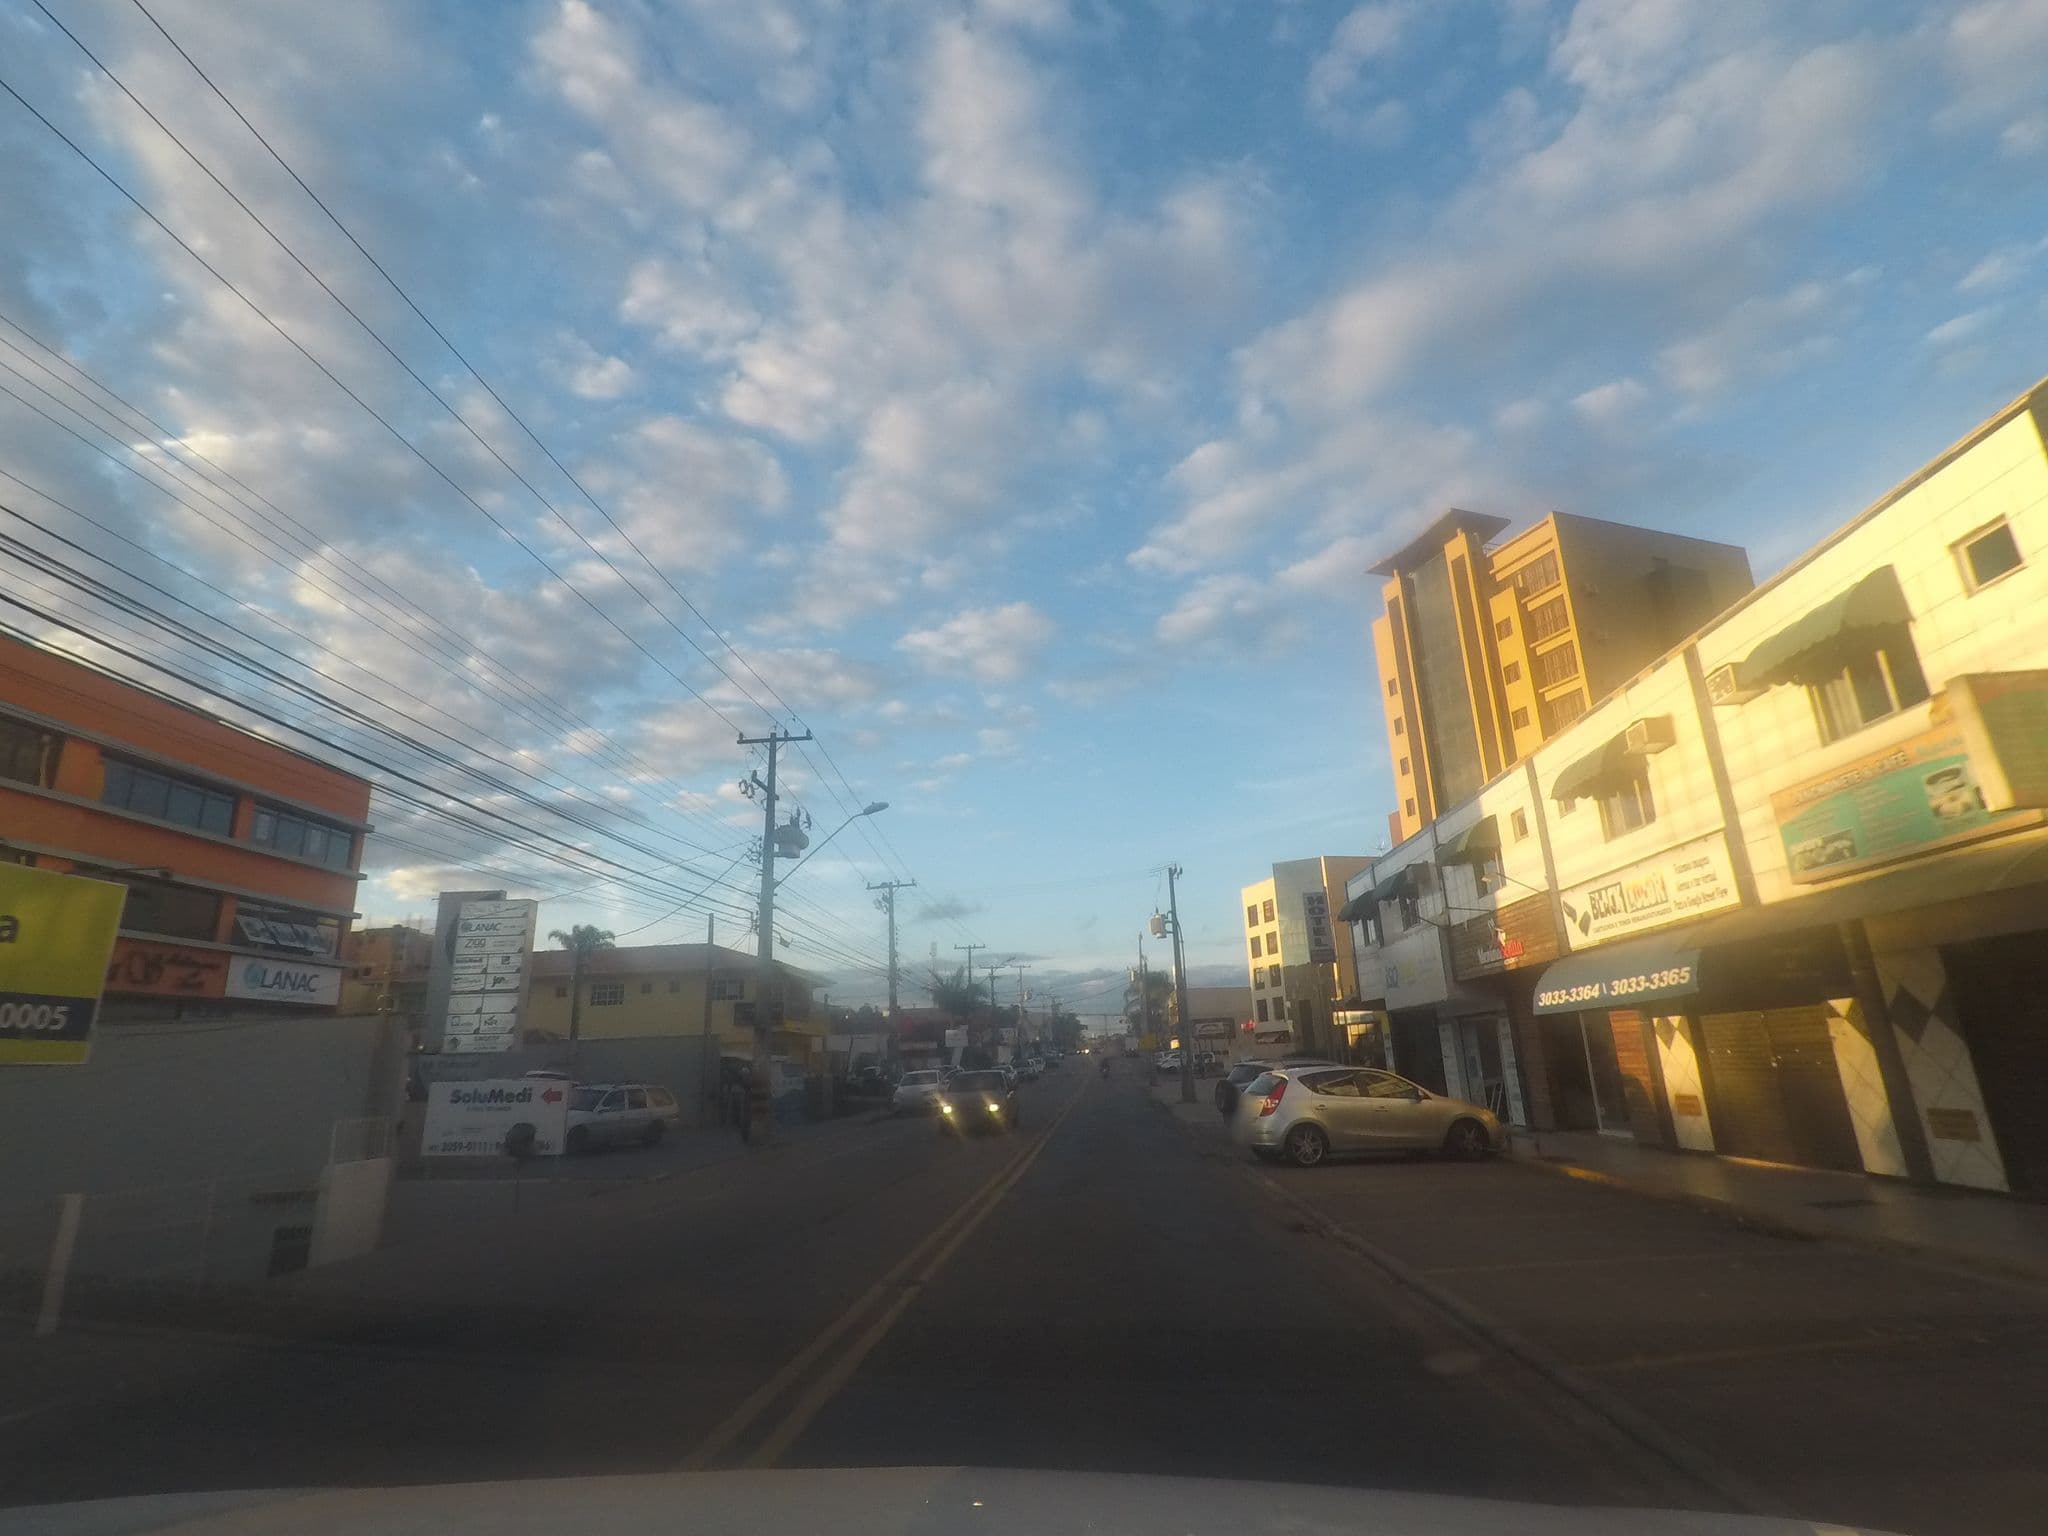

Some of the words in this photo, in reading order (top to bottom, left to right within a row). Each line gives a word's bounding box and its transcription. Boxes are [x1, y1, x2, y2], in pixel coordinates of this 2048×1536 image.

[260, 967, 320, 993] LANAC
[1538, 983, 1600, 1007] 3033-3364
[1610, 966, 1691, 996] 3033-3365
[449, 1087, 532, 1104] SoluMedi
